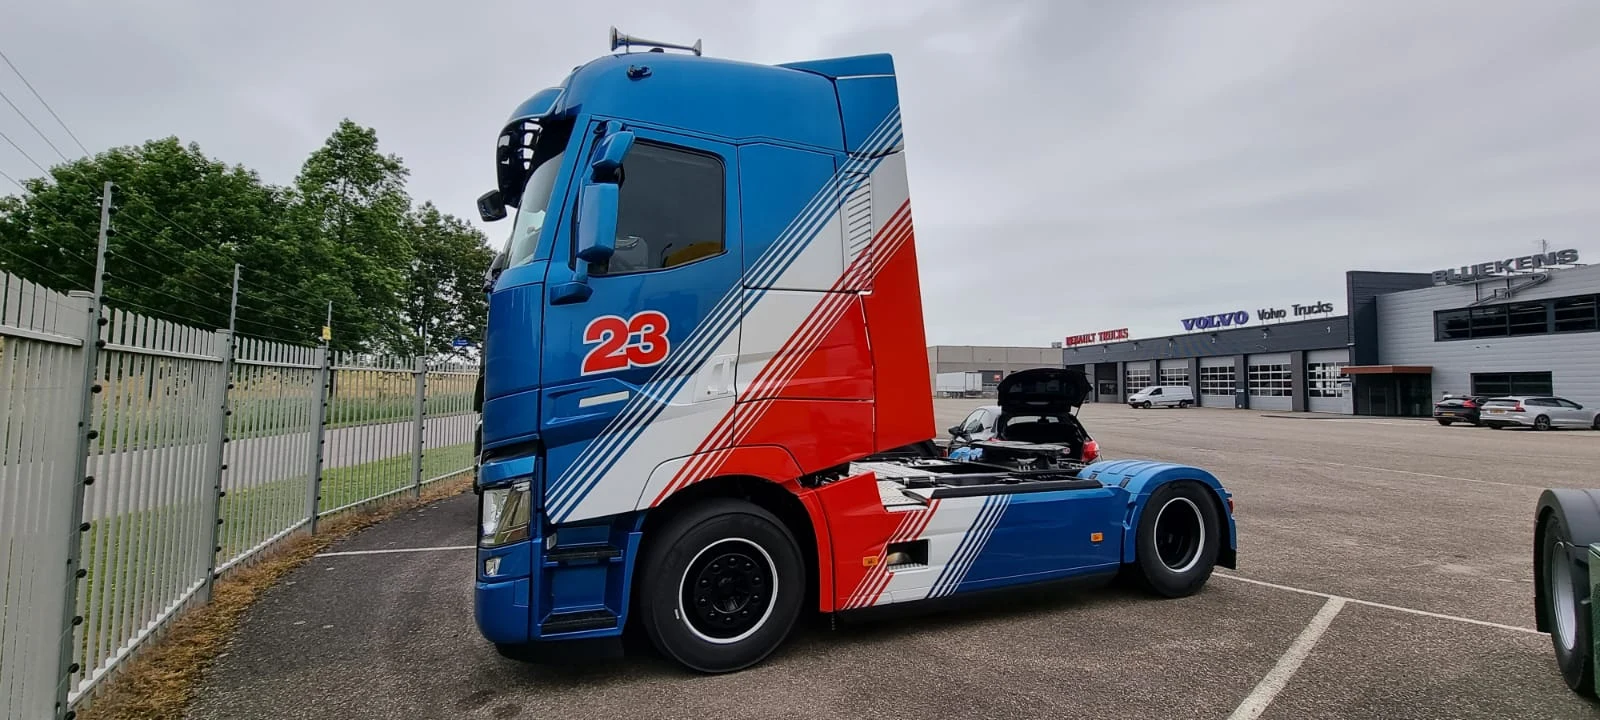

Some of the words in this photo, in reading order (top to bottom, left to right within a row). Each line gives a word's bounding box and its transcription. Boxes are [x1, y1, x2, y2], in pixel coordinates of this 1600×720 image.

[1432, 248, 1579, 283] BLUEKENS
[1181, 310, 1249, 331] VOLVO
[1257, 307, 1287, 321] Volvo
[1291, 301, 1333, 317] Trucks
[581, 310, 670, 376] 23
[1098, 327, 1129, 342] TRUCKS
